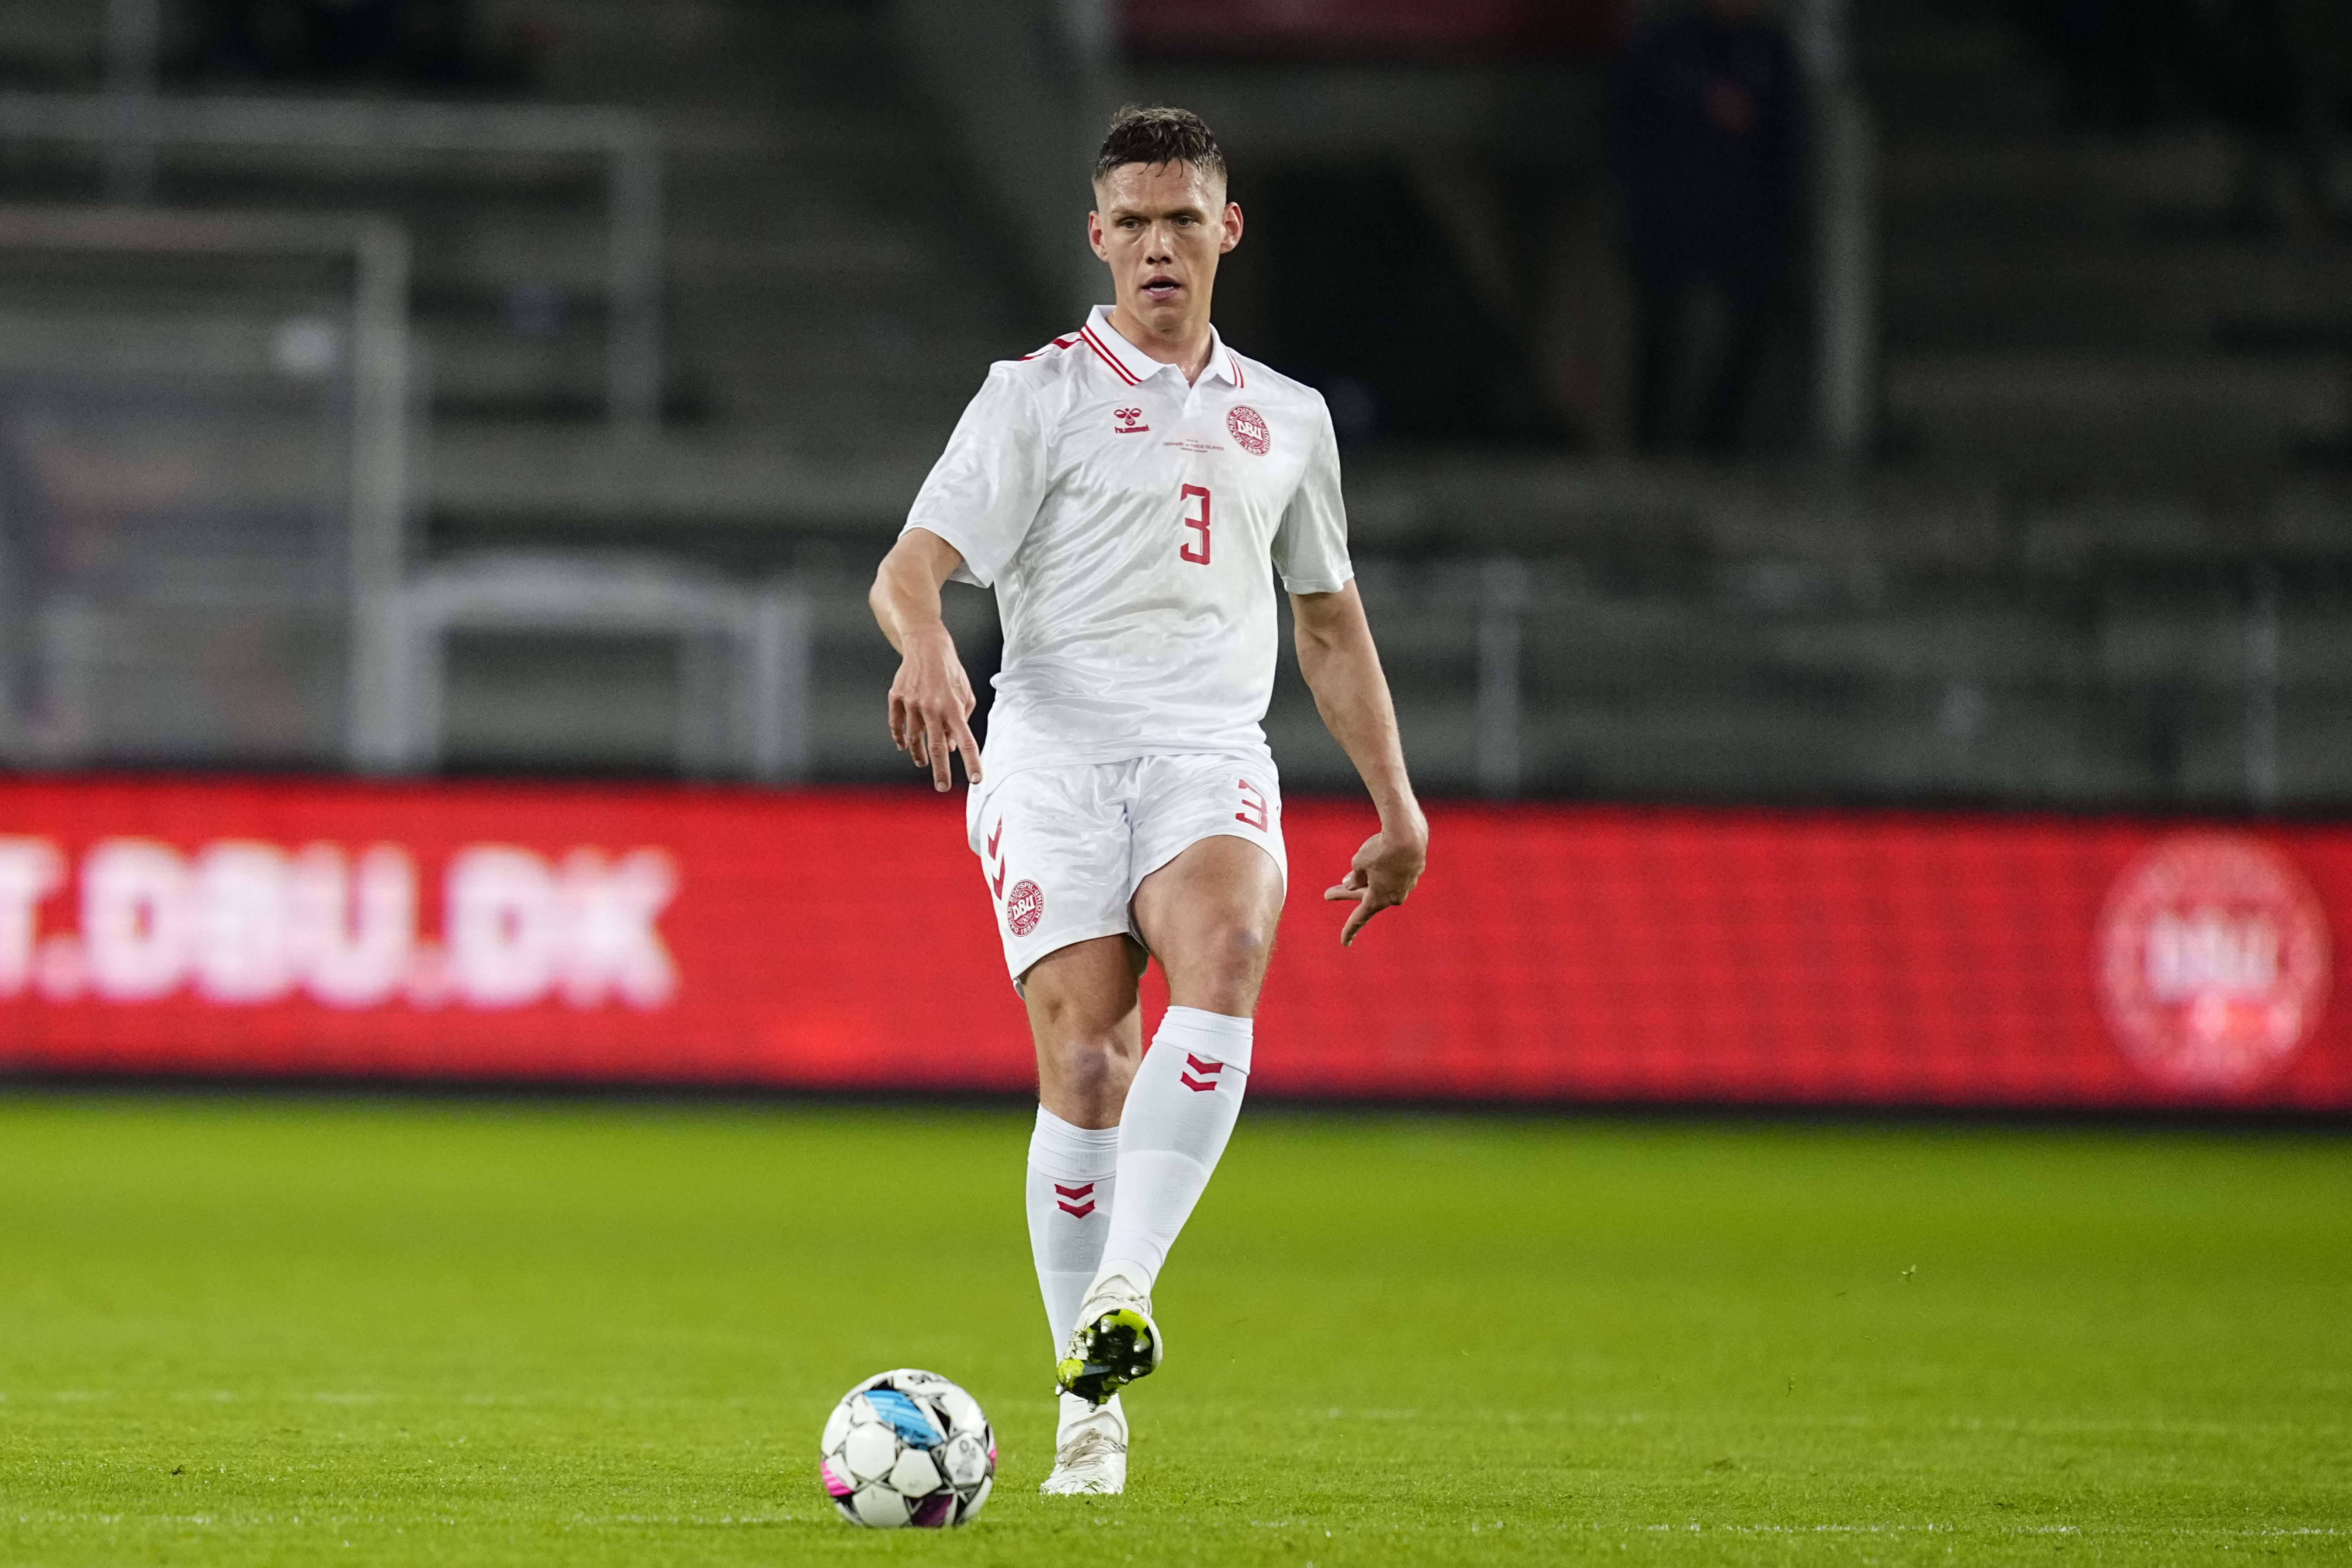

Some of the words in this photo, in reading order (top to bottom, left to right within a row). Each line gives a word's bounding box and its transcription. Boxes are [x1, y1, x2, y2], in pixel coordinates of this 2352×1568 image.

[1115, 425, 1149, 433] hummel
[1236, 419, 1263, 440] DBU
[1245, 444, 1261, 454] 1889
[1180, 483, 1210, 565] 3
[1235, 779, 1268, 833] 3
[1012, 895, 1035, 921] DBU
[1020, 921, 1035, 935] 1889
